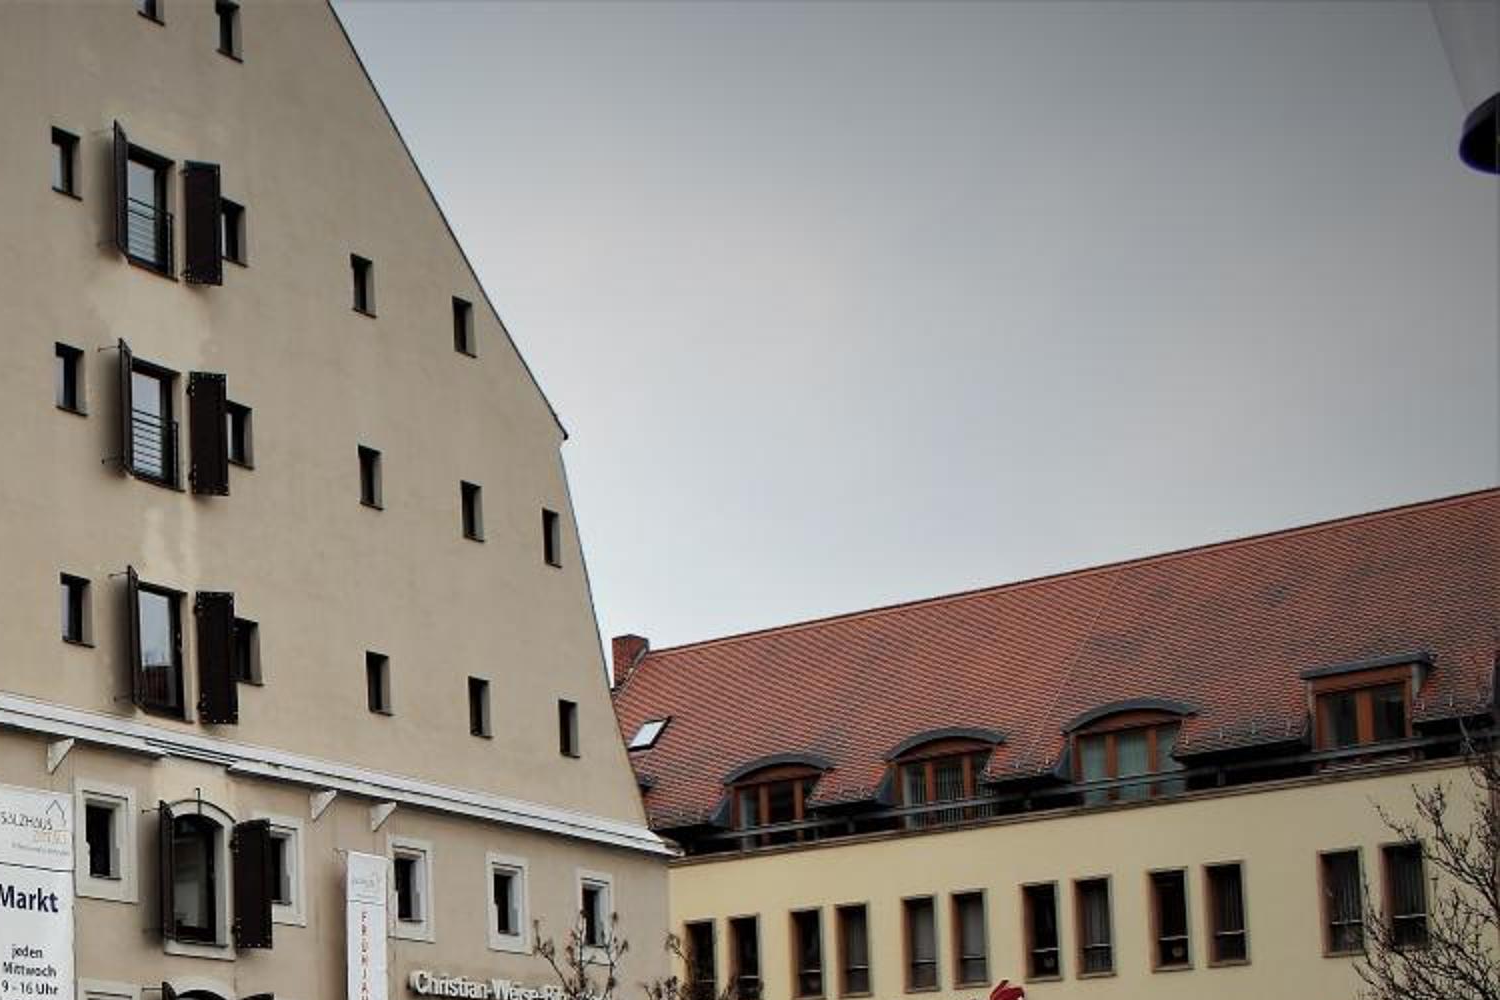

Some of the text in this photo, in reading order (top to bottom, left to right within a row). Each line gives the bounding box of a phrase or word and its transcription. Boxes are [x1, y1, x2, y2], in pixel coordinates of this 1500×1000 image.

[11, 943, 43, 960] jeden
[3, 961, 57, 978] Mittwoch
[1, 980, 9, 992] 9
[20, 982, 33, 994] 16
[36, 983, 58, 995] Uhr
